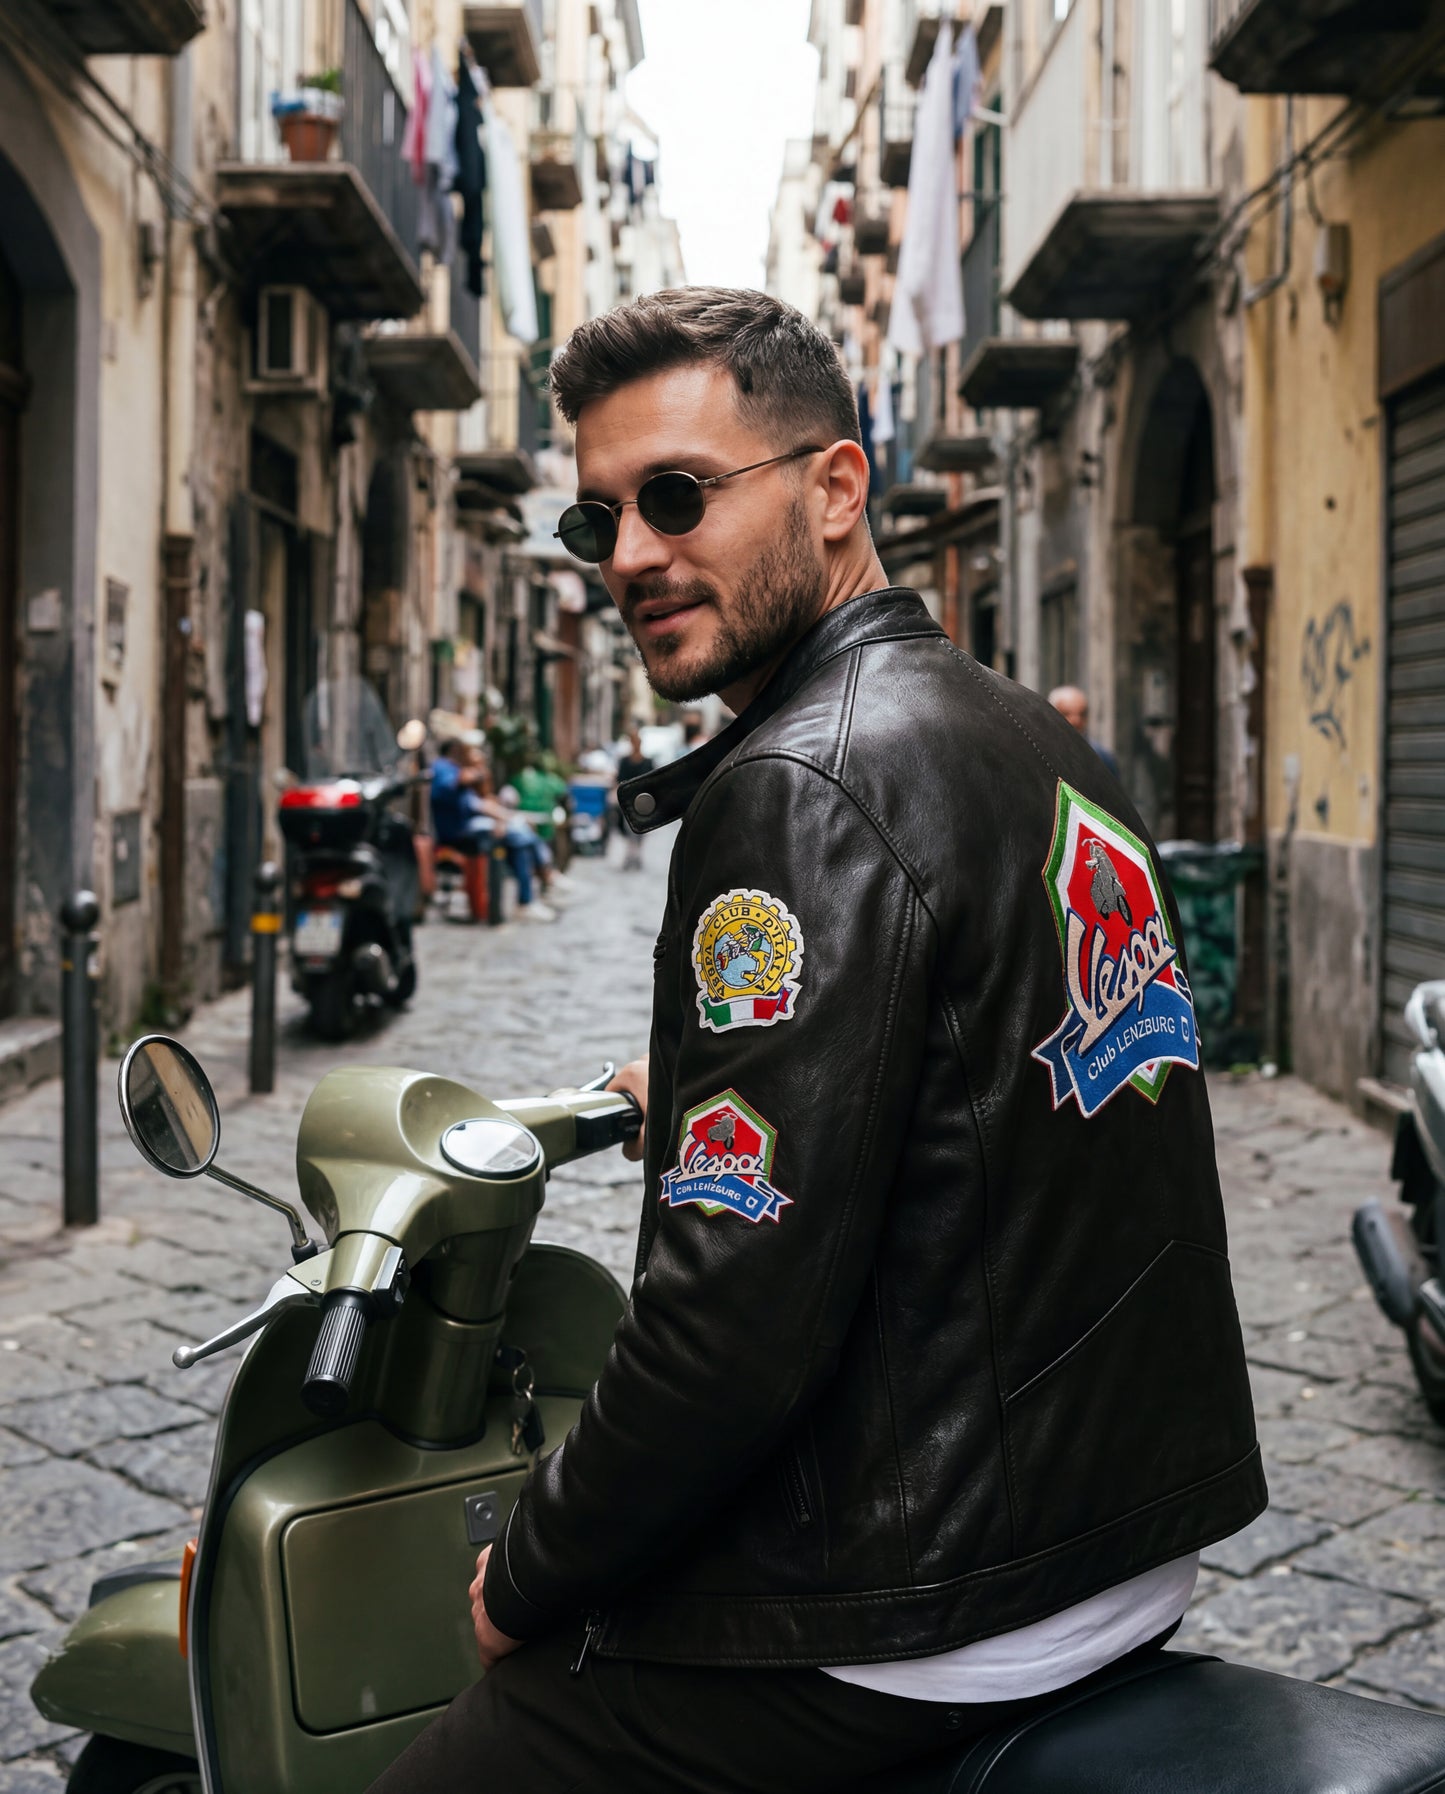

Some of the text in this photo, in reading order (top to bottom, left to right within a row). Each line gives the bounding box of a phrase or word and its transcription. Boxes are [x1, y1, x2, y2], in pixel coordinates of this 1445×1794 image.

[714, 907, 751, 929] CLUB
[1066, 910, 1177, 1057] Vespa
[1087, 1015, 1176, 1080] Club LENZBURG
